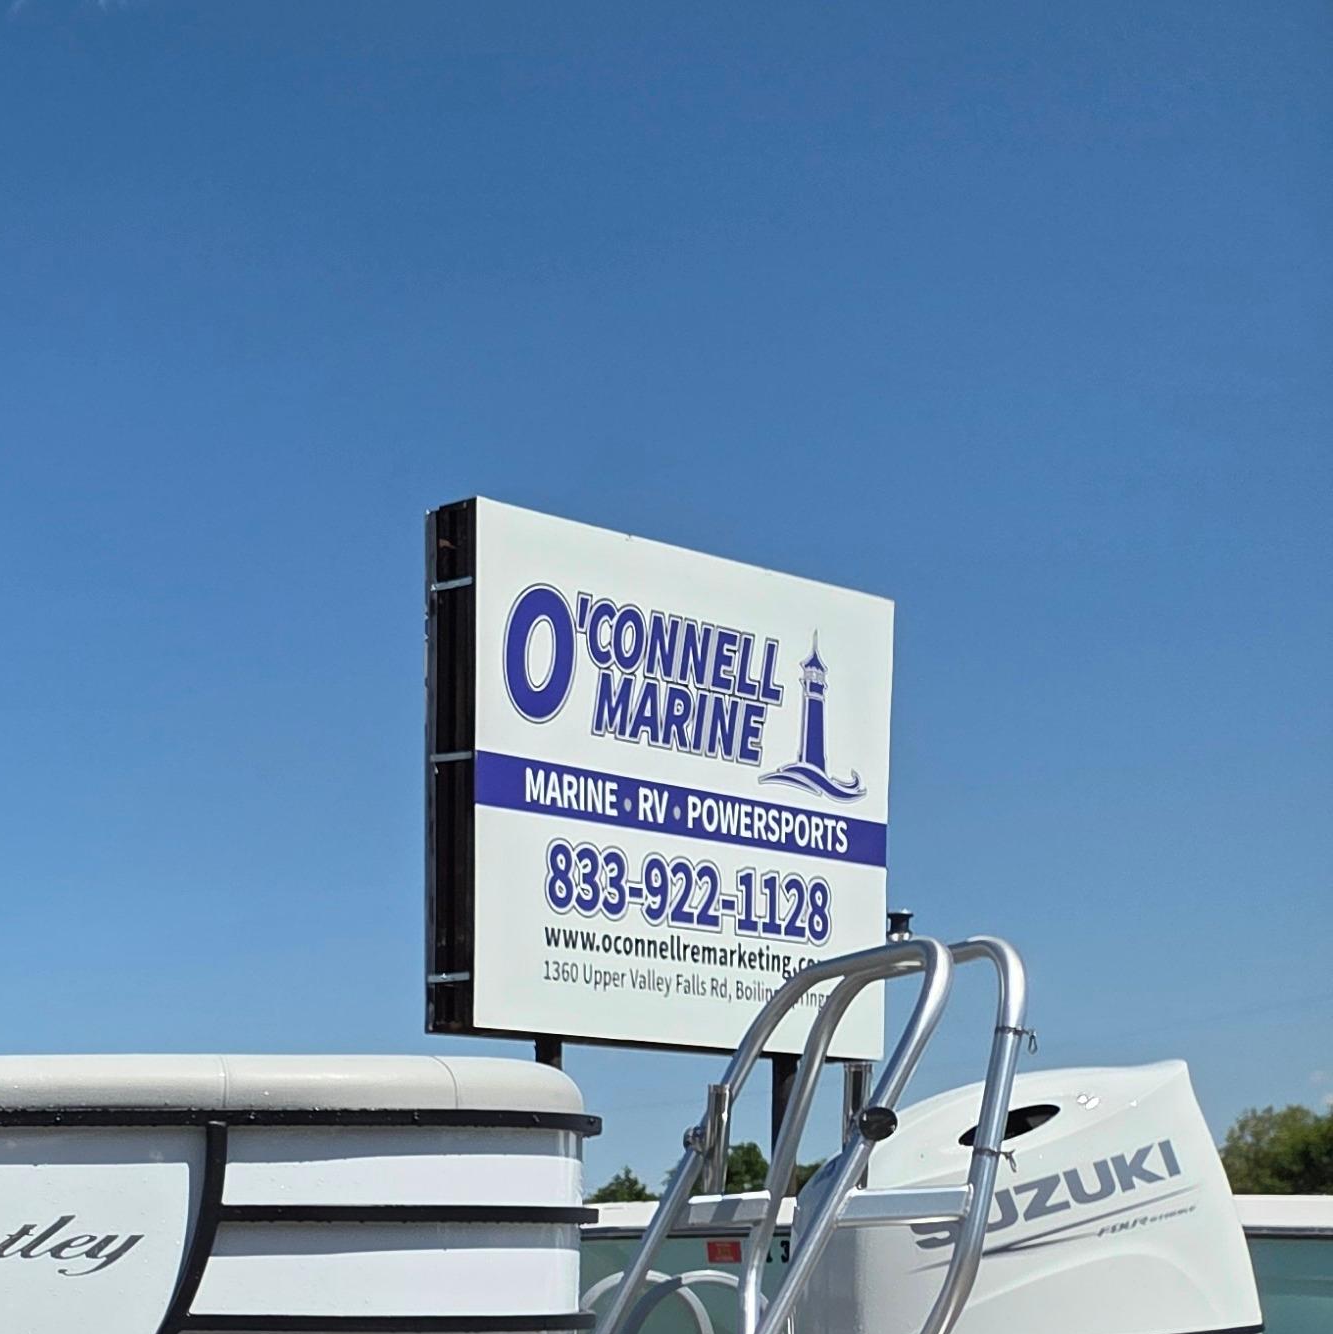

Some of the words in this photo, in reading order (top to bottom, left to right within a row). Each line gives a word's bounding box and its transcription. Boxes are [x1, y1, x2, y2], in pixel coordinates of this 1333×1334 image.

[504, 584, 782, 724] O'CONNELL
[592, 668, 767, 767] MARINE
[524, 767, 619, 817] MARINE
[637, 786, 669, 824] RV
[686, 795, 849, 853] POWERSPORTS
[546, 840, 831, 944] 833-922-1128
[544, 926, 821, 982] www.oconnellremarketing.c
[544, 960, 579, 983] 1360
[583, 962, 627, 992] Upper
[629, 968, 672, 998] Valley
[676, 973, 707, 997] Falls
[711, 977, 732, 1003] Rd,
[736, 980, 775, 1003] Boilin
